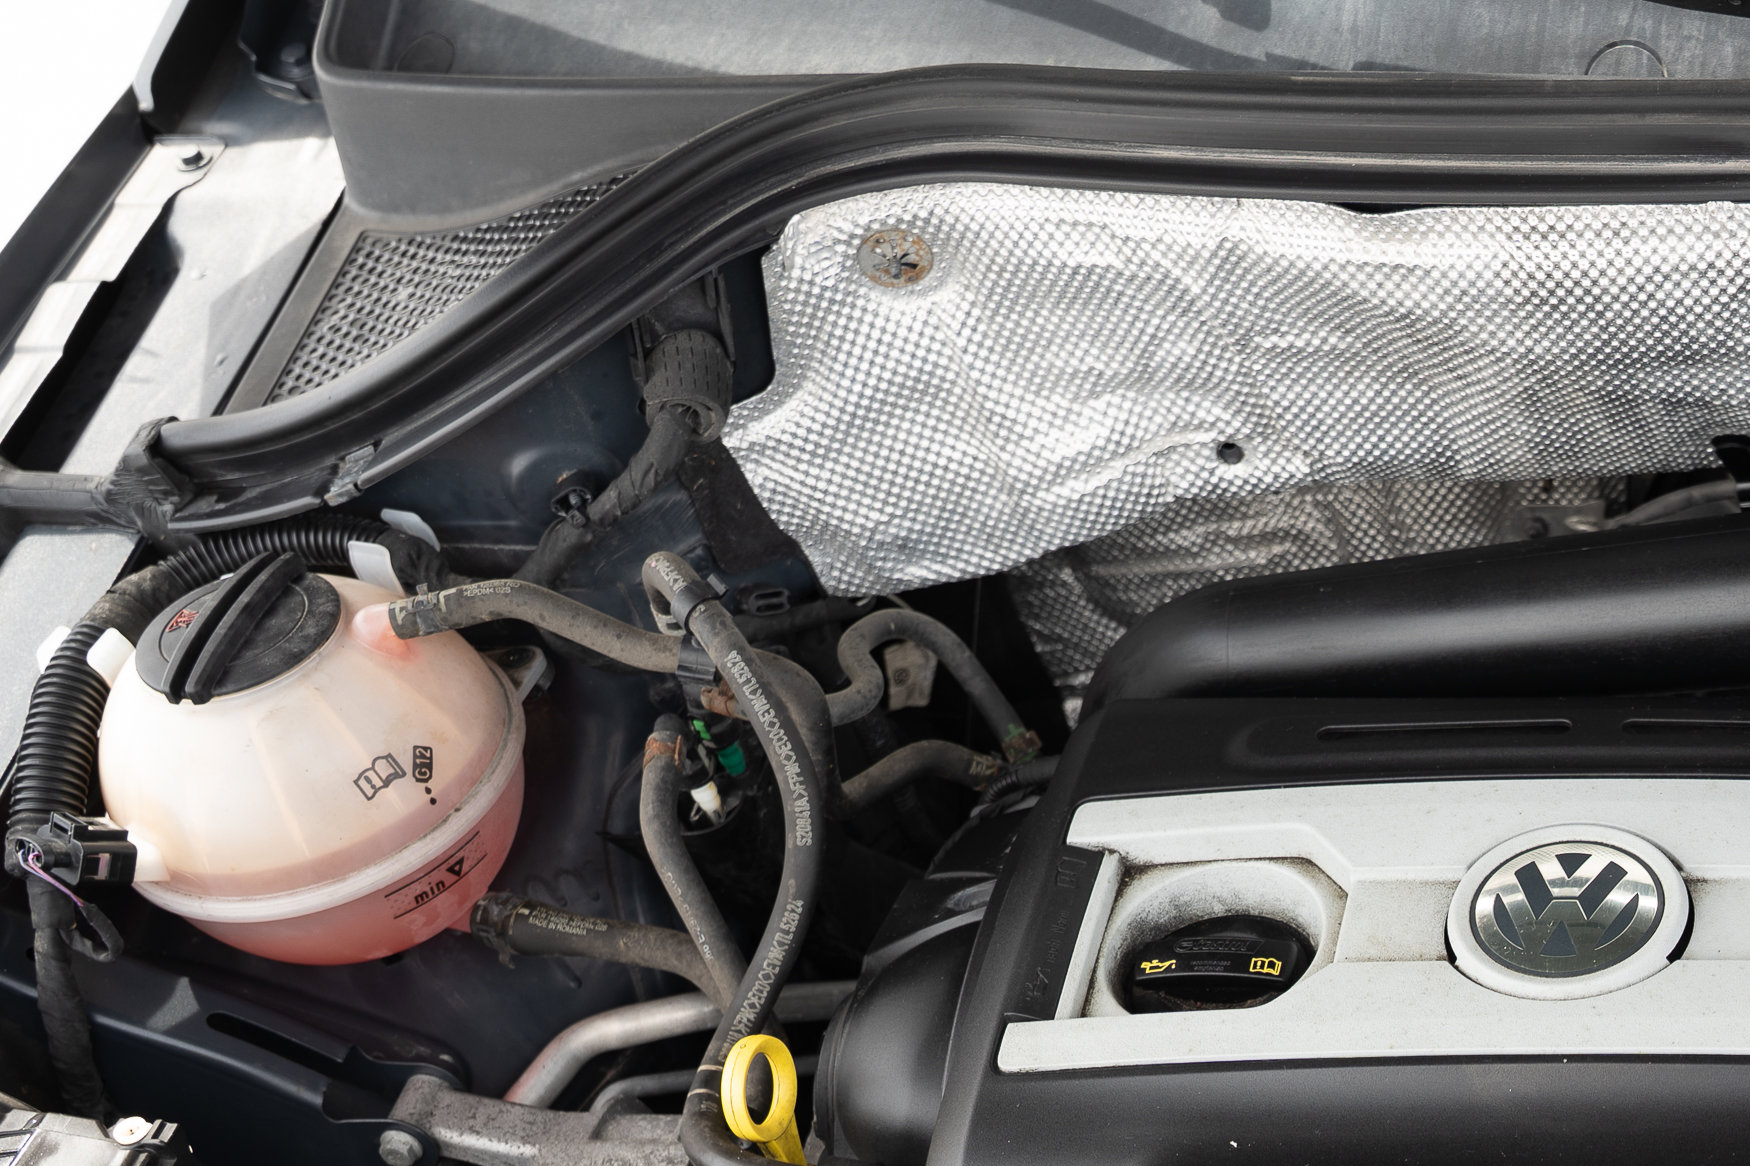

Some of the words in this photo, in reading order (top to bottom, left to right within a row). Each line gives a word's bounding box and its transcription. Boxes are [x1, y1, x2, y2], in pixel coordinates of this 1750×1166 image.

[415, 748, 431, 779] G12
[413, 879, 447, 905] min
[528, 916, 548, 928] MADE
[548, 921, 556, 930] IN
[556, 922, 587, 936] ROMANIA
